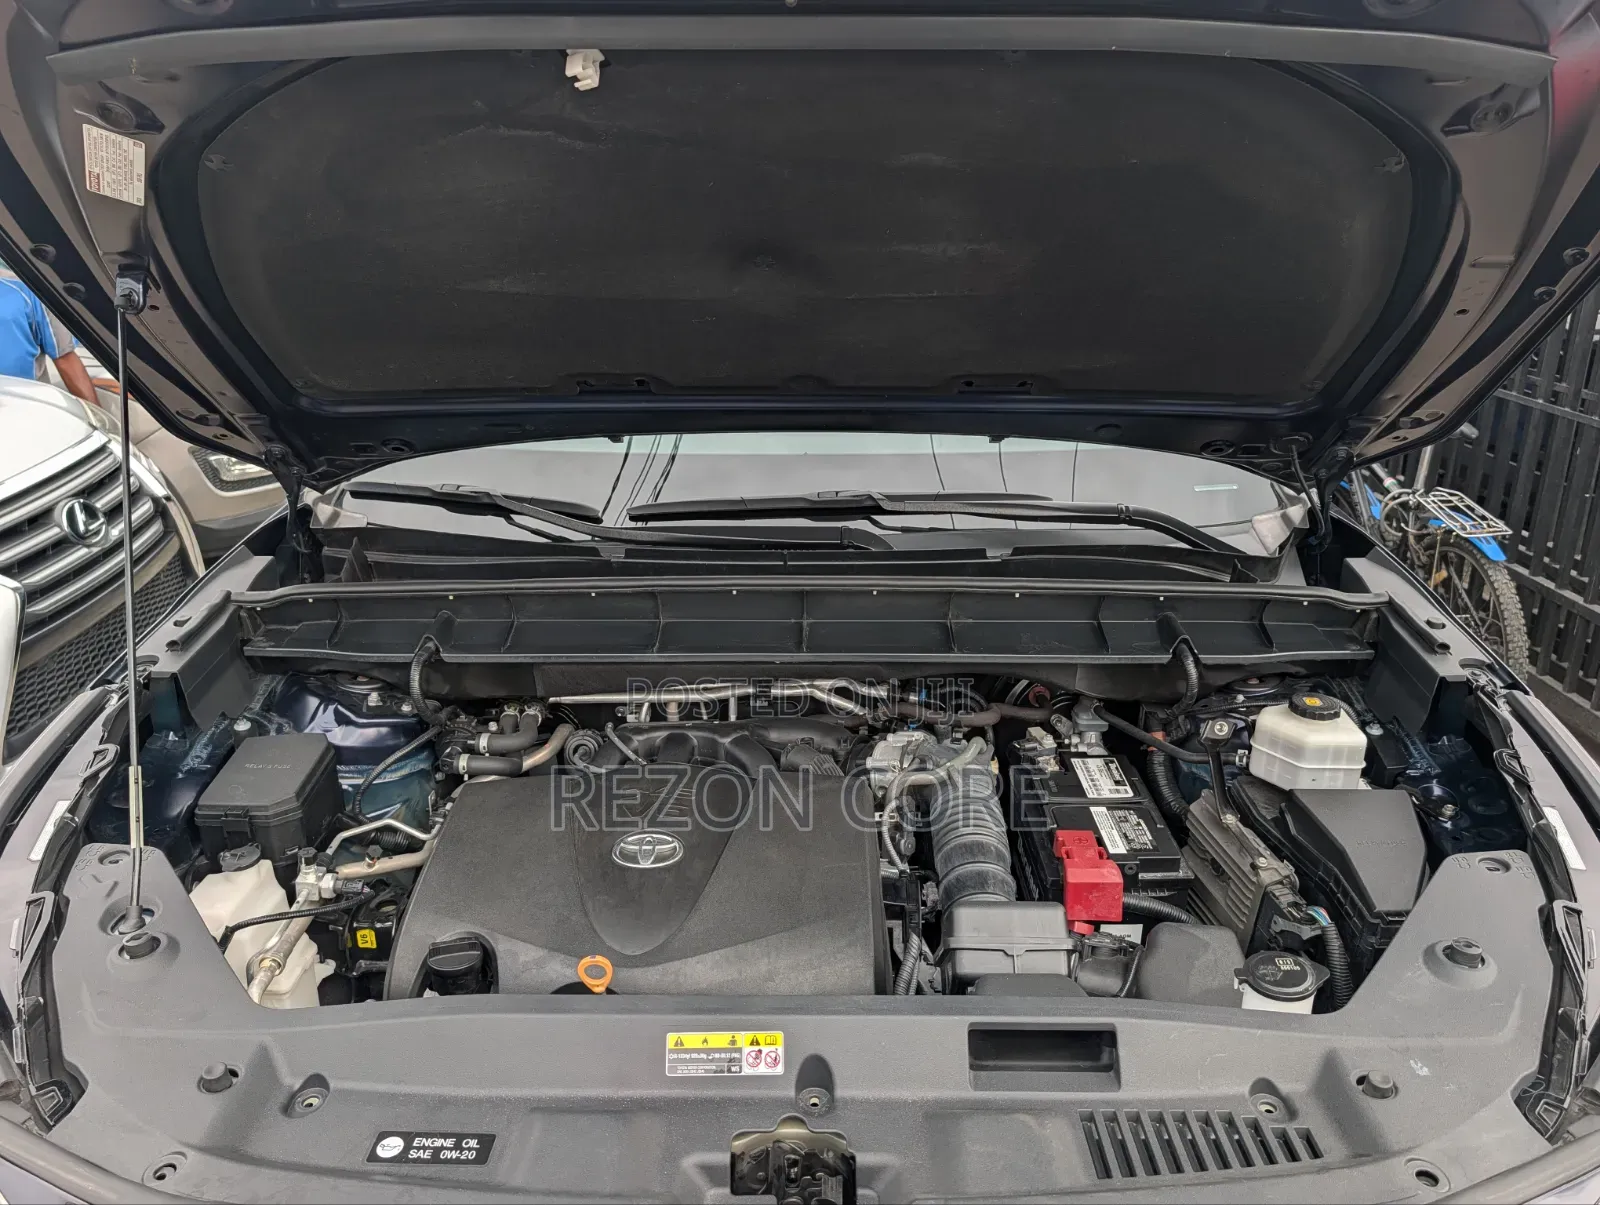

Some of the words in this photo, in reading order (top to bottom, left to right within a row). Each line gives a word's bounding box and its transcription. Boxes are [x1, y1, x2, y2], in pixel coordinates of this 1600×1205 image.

[413, 1137, 456, 1147] ENGINE
[462, 1138, 480, 1148] OIL
[408, 1149, 433, 1159] SAE
[439, 1150, 476, 1160] 0W-20
